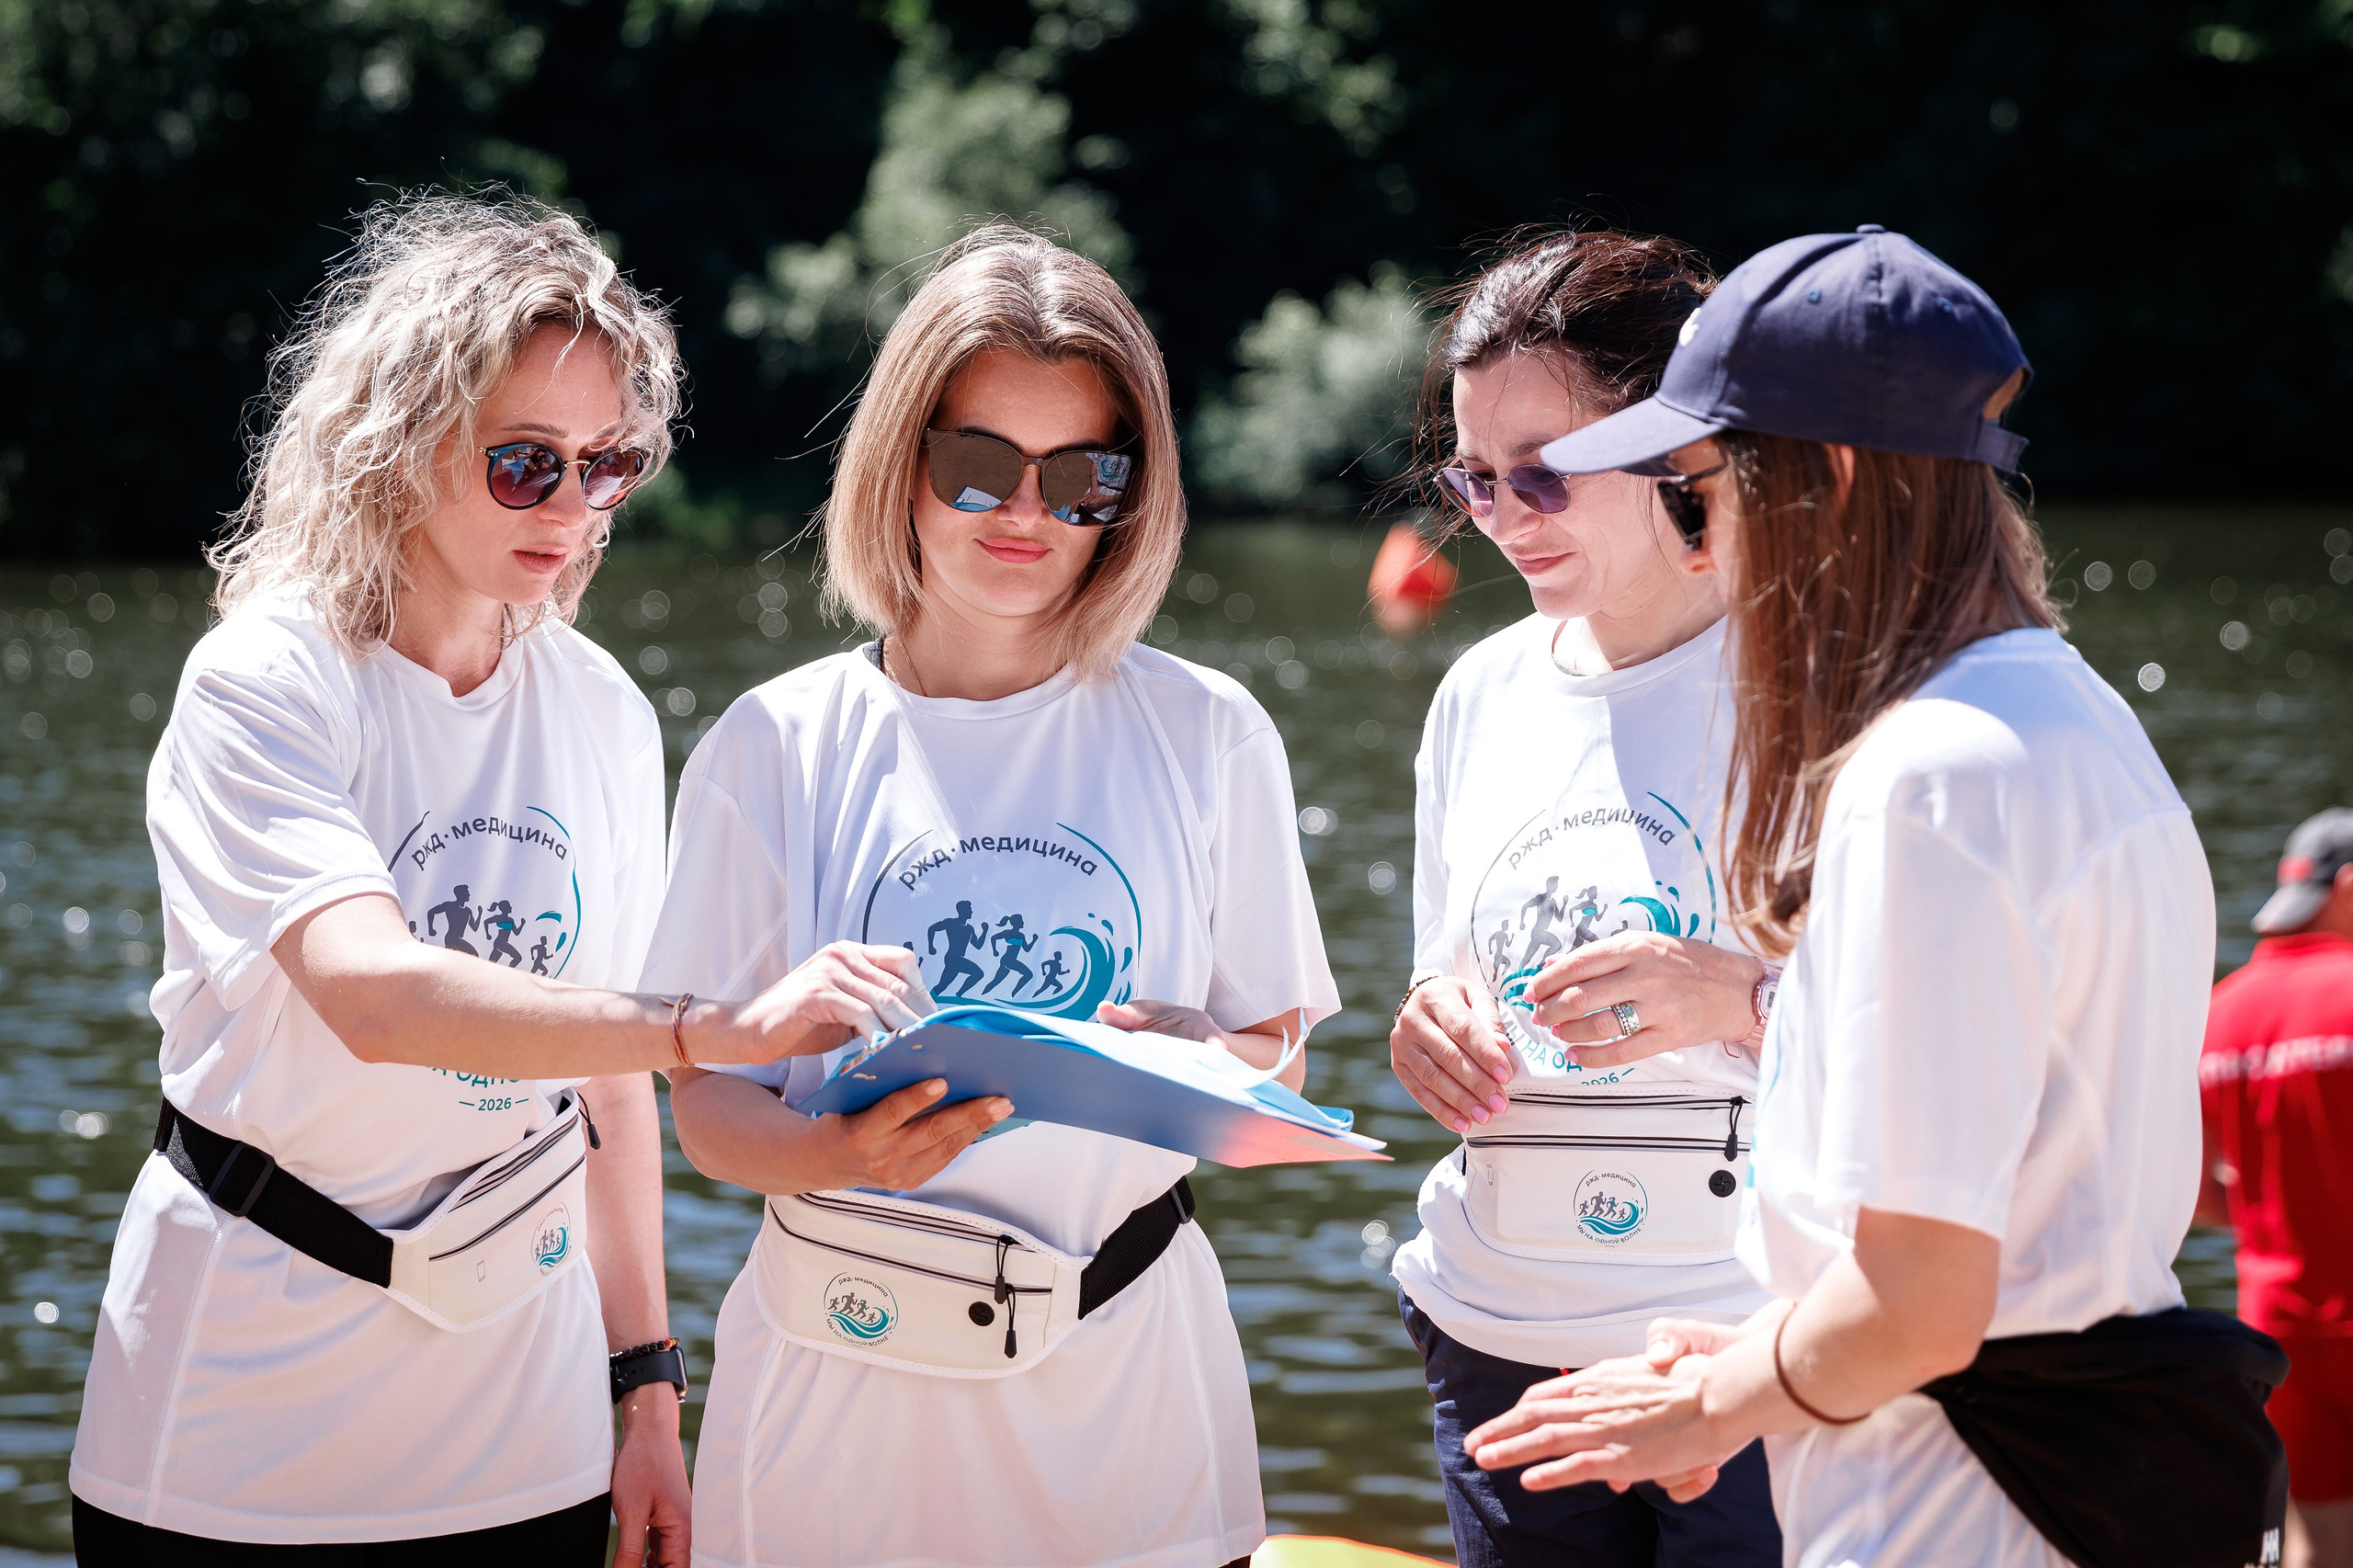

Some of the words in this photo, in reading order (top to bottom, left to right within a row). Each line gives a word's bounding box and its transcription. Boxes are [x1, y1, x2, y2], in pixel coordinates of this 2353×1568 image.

[1519, 1039, 1546, 1065] НА
[478, 1097, 512, 1111] 2026
[1576, 1224, 1585, 1234] МЫ
[1585, 1233, 1594, 1241] НА
[1620, 1227, 1642, 1243] ВОЛНЕ
[826, 1318, 835, 1331] МЫ
[844, 1336, 868, 1346] ОДНОЙ
[869, 1335, 890, 1346] ВОЛНЕ
